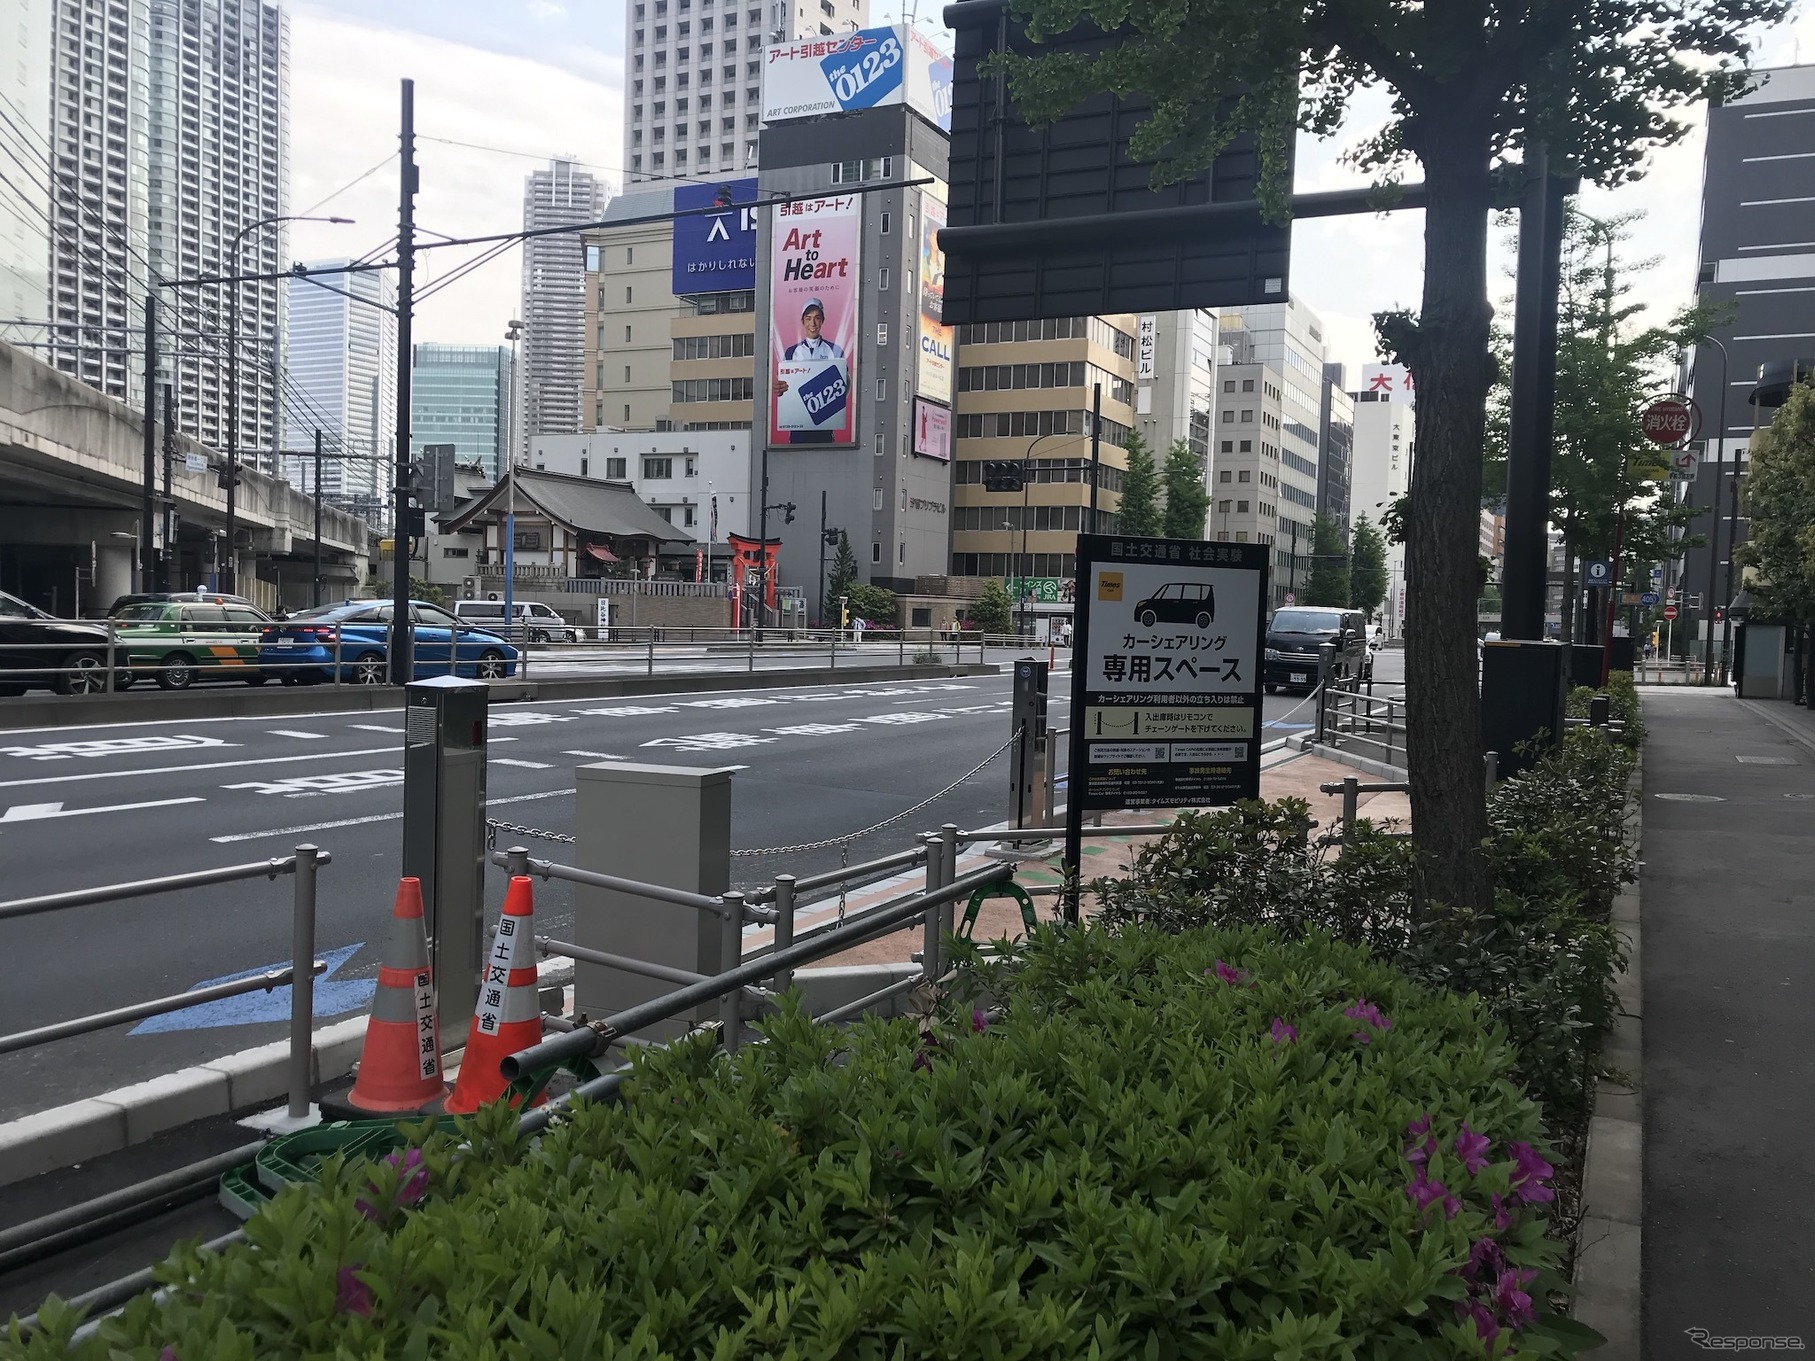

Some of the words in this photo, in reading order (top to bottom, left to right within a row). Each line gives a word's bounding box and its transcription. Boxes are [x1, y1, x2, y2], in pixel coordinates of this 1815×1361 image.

[770, 36, 877, 63] アート引越センター
[829, 65, 846, 82] the
[835, 37, 902, 102] 0123
[767, 107, 782, 118] ART
[783, 101, 836, 115] CORPORATION
[782, 228, 822, 251] Art
[805, 249, 819, 261] to
[784, 258, 848, 281] Heart
[921, 336, 951, 361] CALL
[1140, 321, 1153, 374] 村松ビル
[807, 379, 846, 413] 0123
[1646, 414, 1688, 431] 消火栓
[1111, 542, 1180, 560] 国土交通省
[1189, 546, 1242, 562] 社会実験
[1101, 580, 1121, 589] Times
[1122, 633, 1227, 651] カーシェアリング
[1103, 654, 1242, 682] 専用スペース
[1098, 694, 1245, 705] カーシェアリング利用者以外の立ち入りは禁止
[1145, 712, 1213, 722] 入出庫時はリモコンで
[1145, 724, 1247, 734] チェーンゲートを下げてください。
[1108, 768, 1147, 776] お問い合わせ先
[481, 919, 515, 1031] 国土交通省
[418, 971, 435, 1076] 国土交通省
